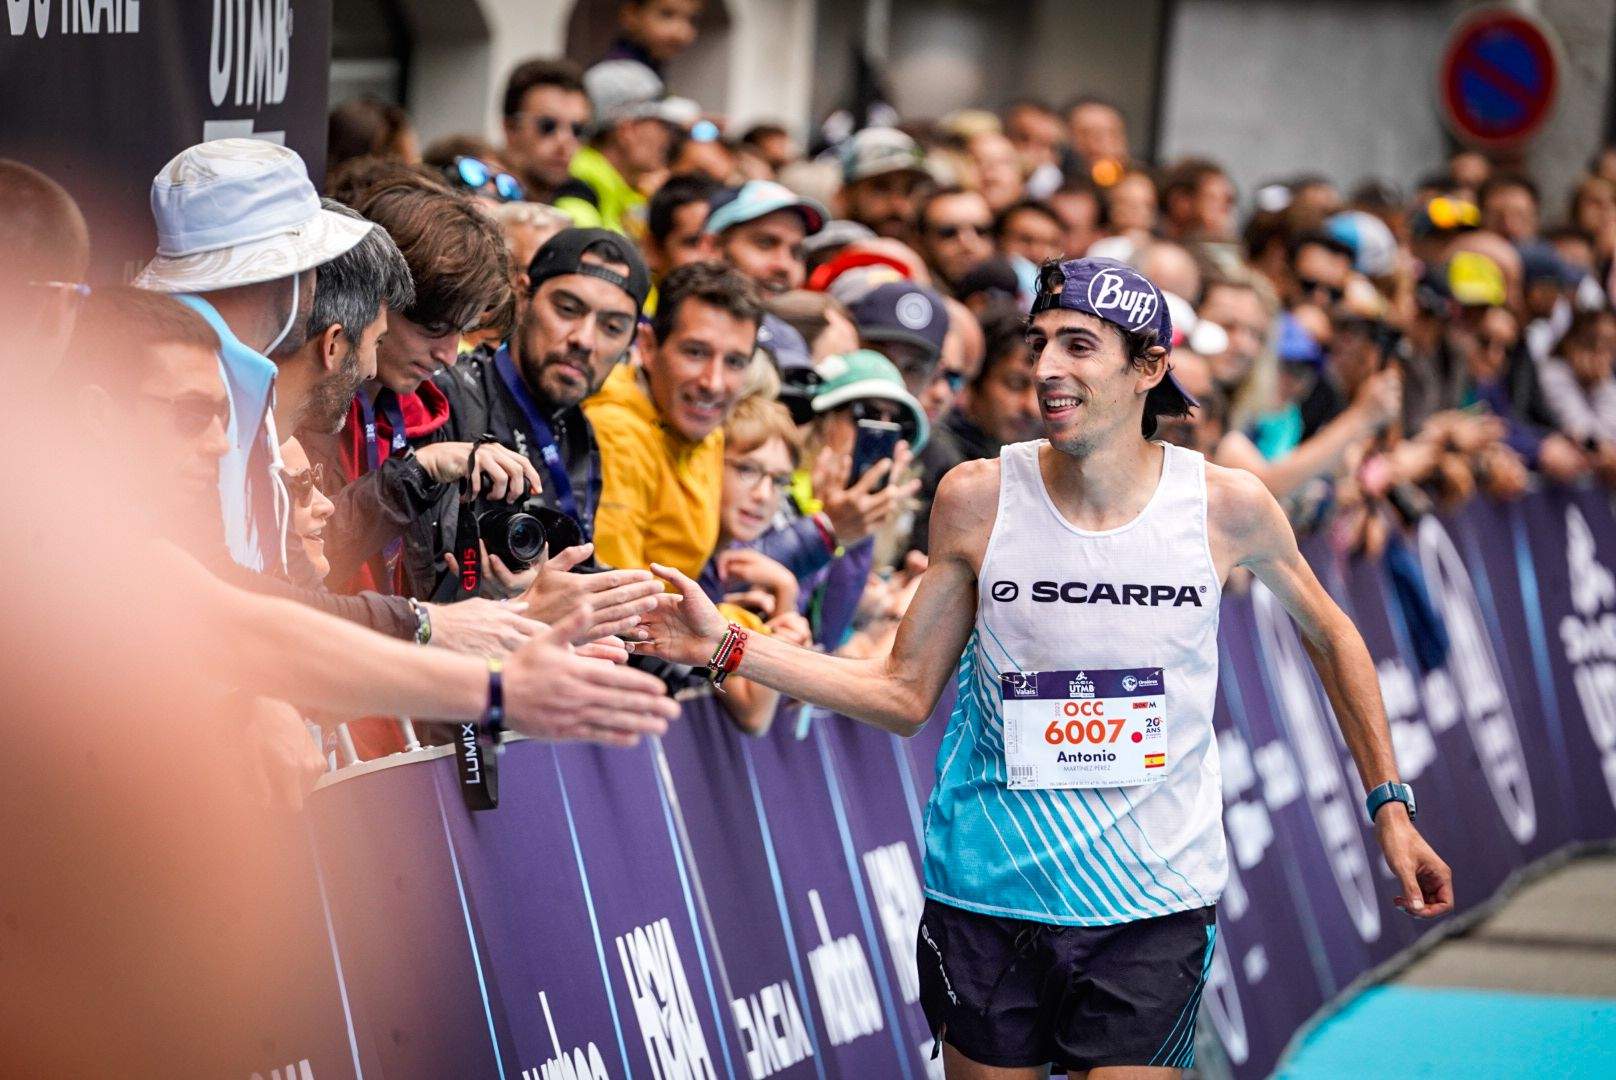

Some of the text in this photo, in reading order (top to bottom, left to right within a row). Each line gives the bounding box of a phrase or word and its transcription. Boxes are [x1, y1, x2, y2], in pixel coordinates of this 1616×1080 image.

[463, 548, 477, 592] GH5
[1015, 687, 1036, 696] Valais
[1069, 684, 1095, 693] UTMB
[1063, 701, 1104, 717] OCC
[1045, 719, 1126, 745] 6007
[462, 723, 481, 785] LUMIX
[1057, 750, 1117, 763] Antonio
